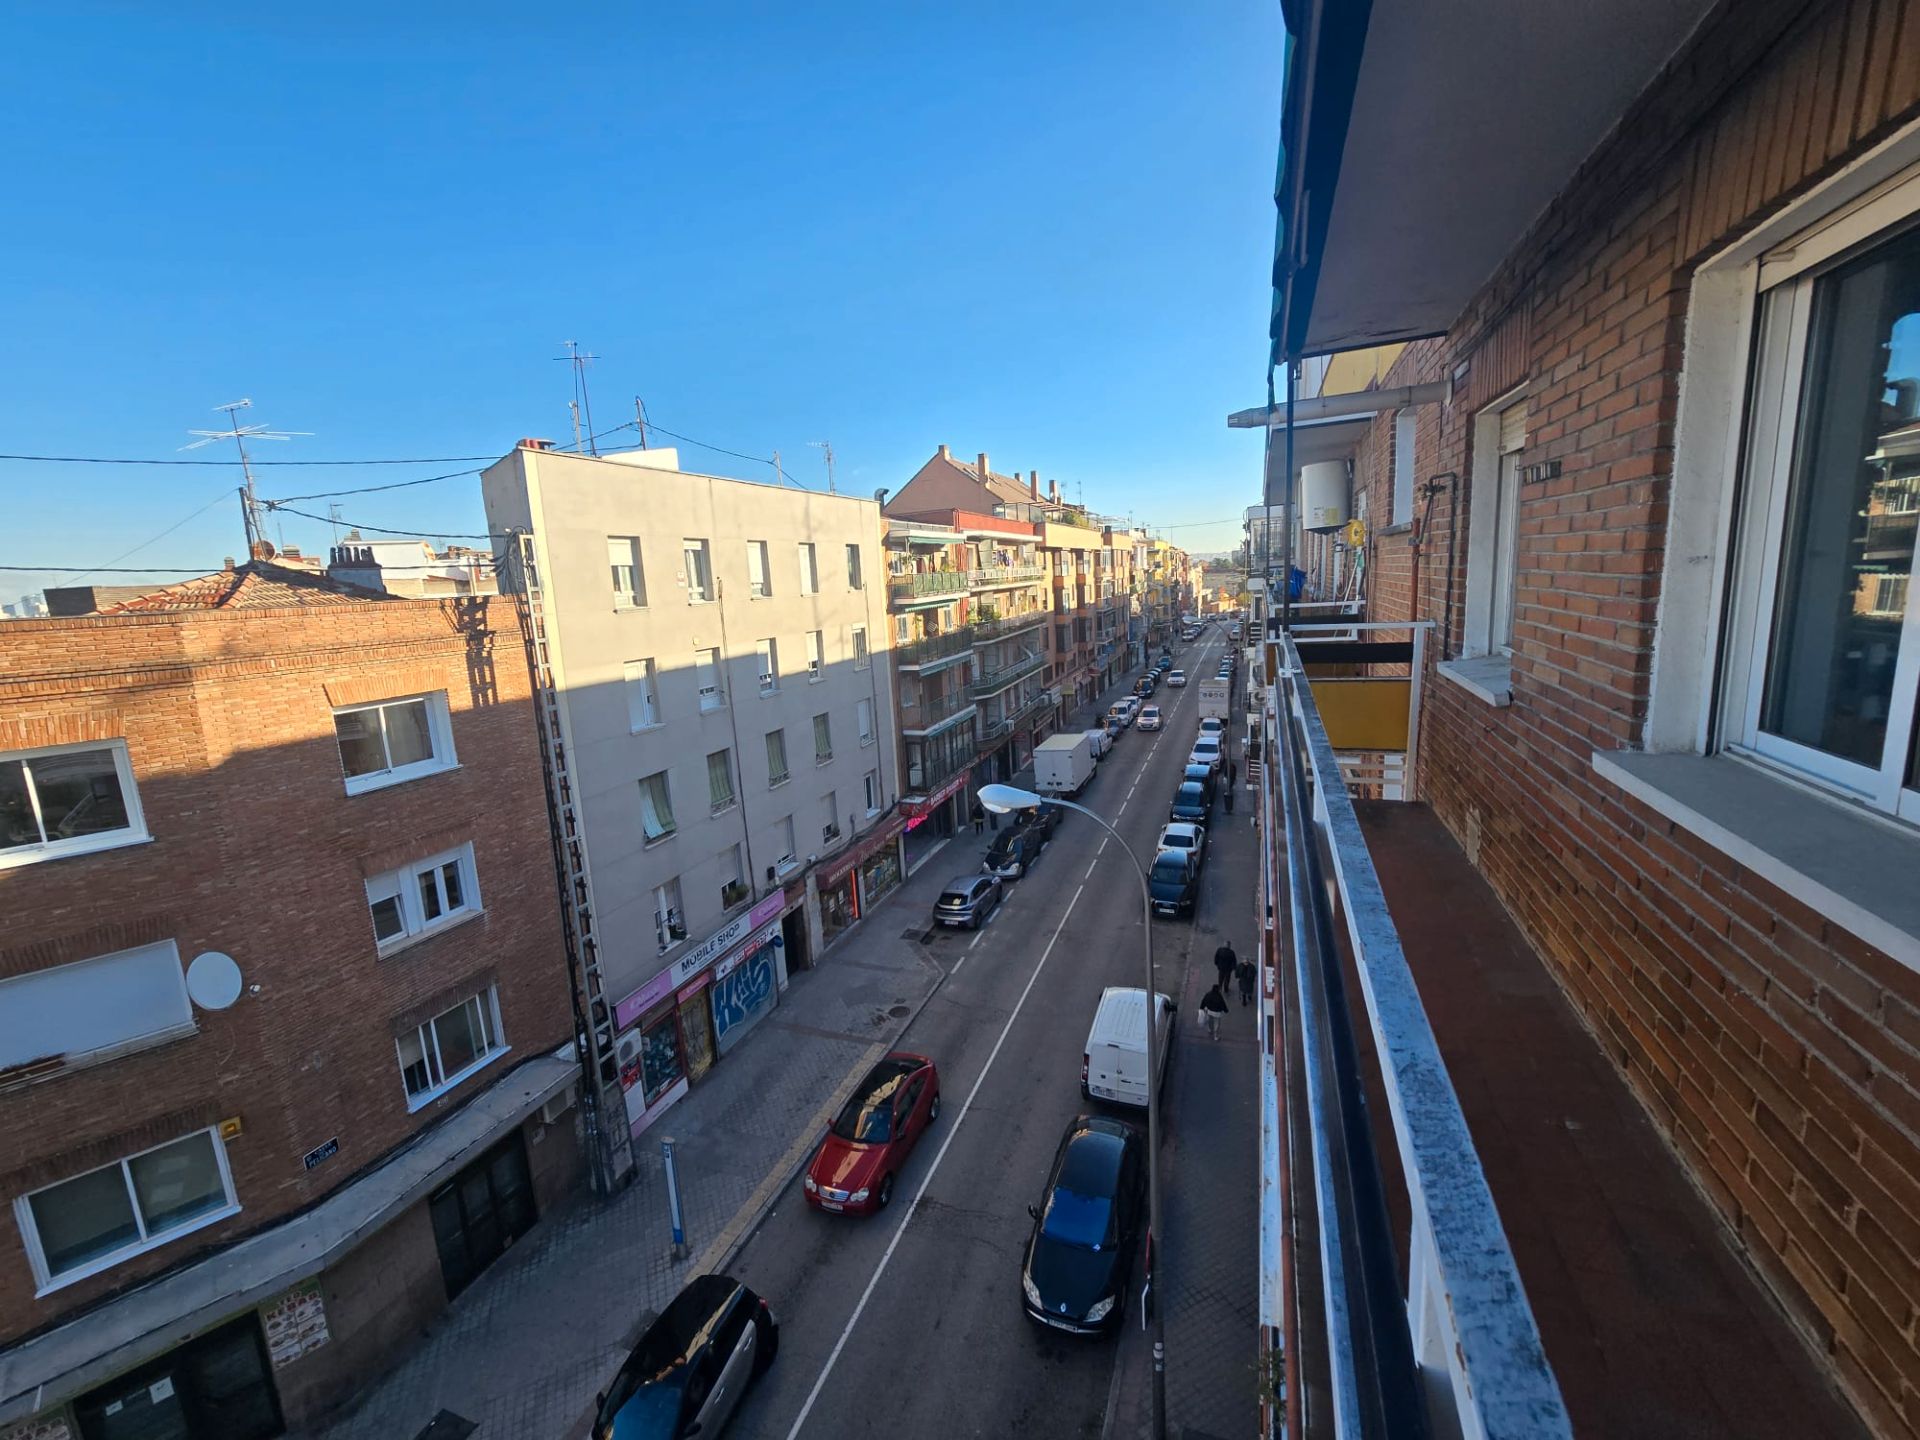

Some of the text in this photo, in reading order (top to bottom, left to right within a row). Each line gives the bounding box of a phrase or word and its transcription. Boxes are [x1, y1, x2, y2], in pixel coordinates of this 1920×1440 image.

[682, 941, 715, 972] MOBILE
[718, 924, 739, 946] SHOP
[266, 1291, 318, 1320] KEBAB
